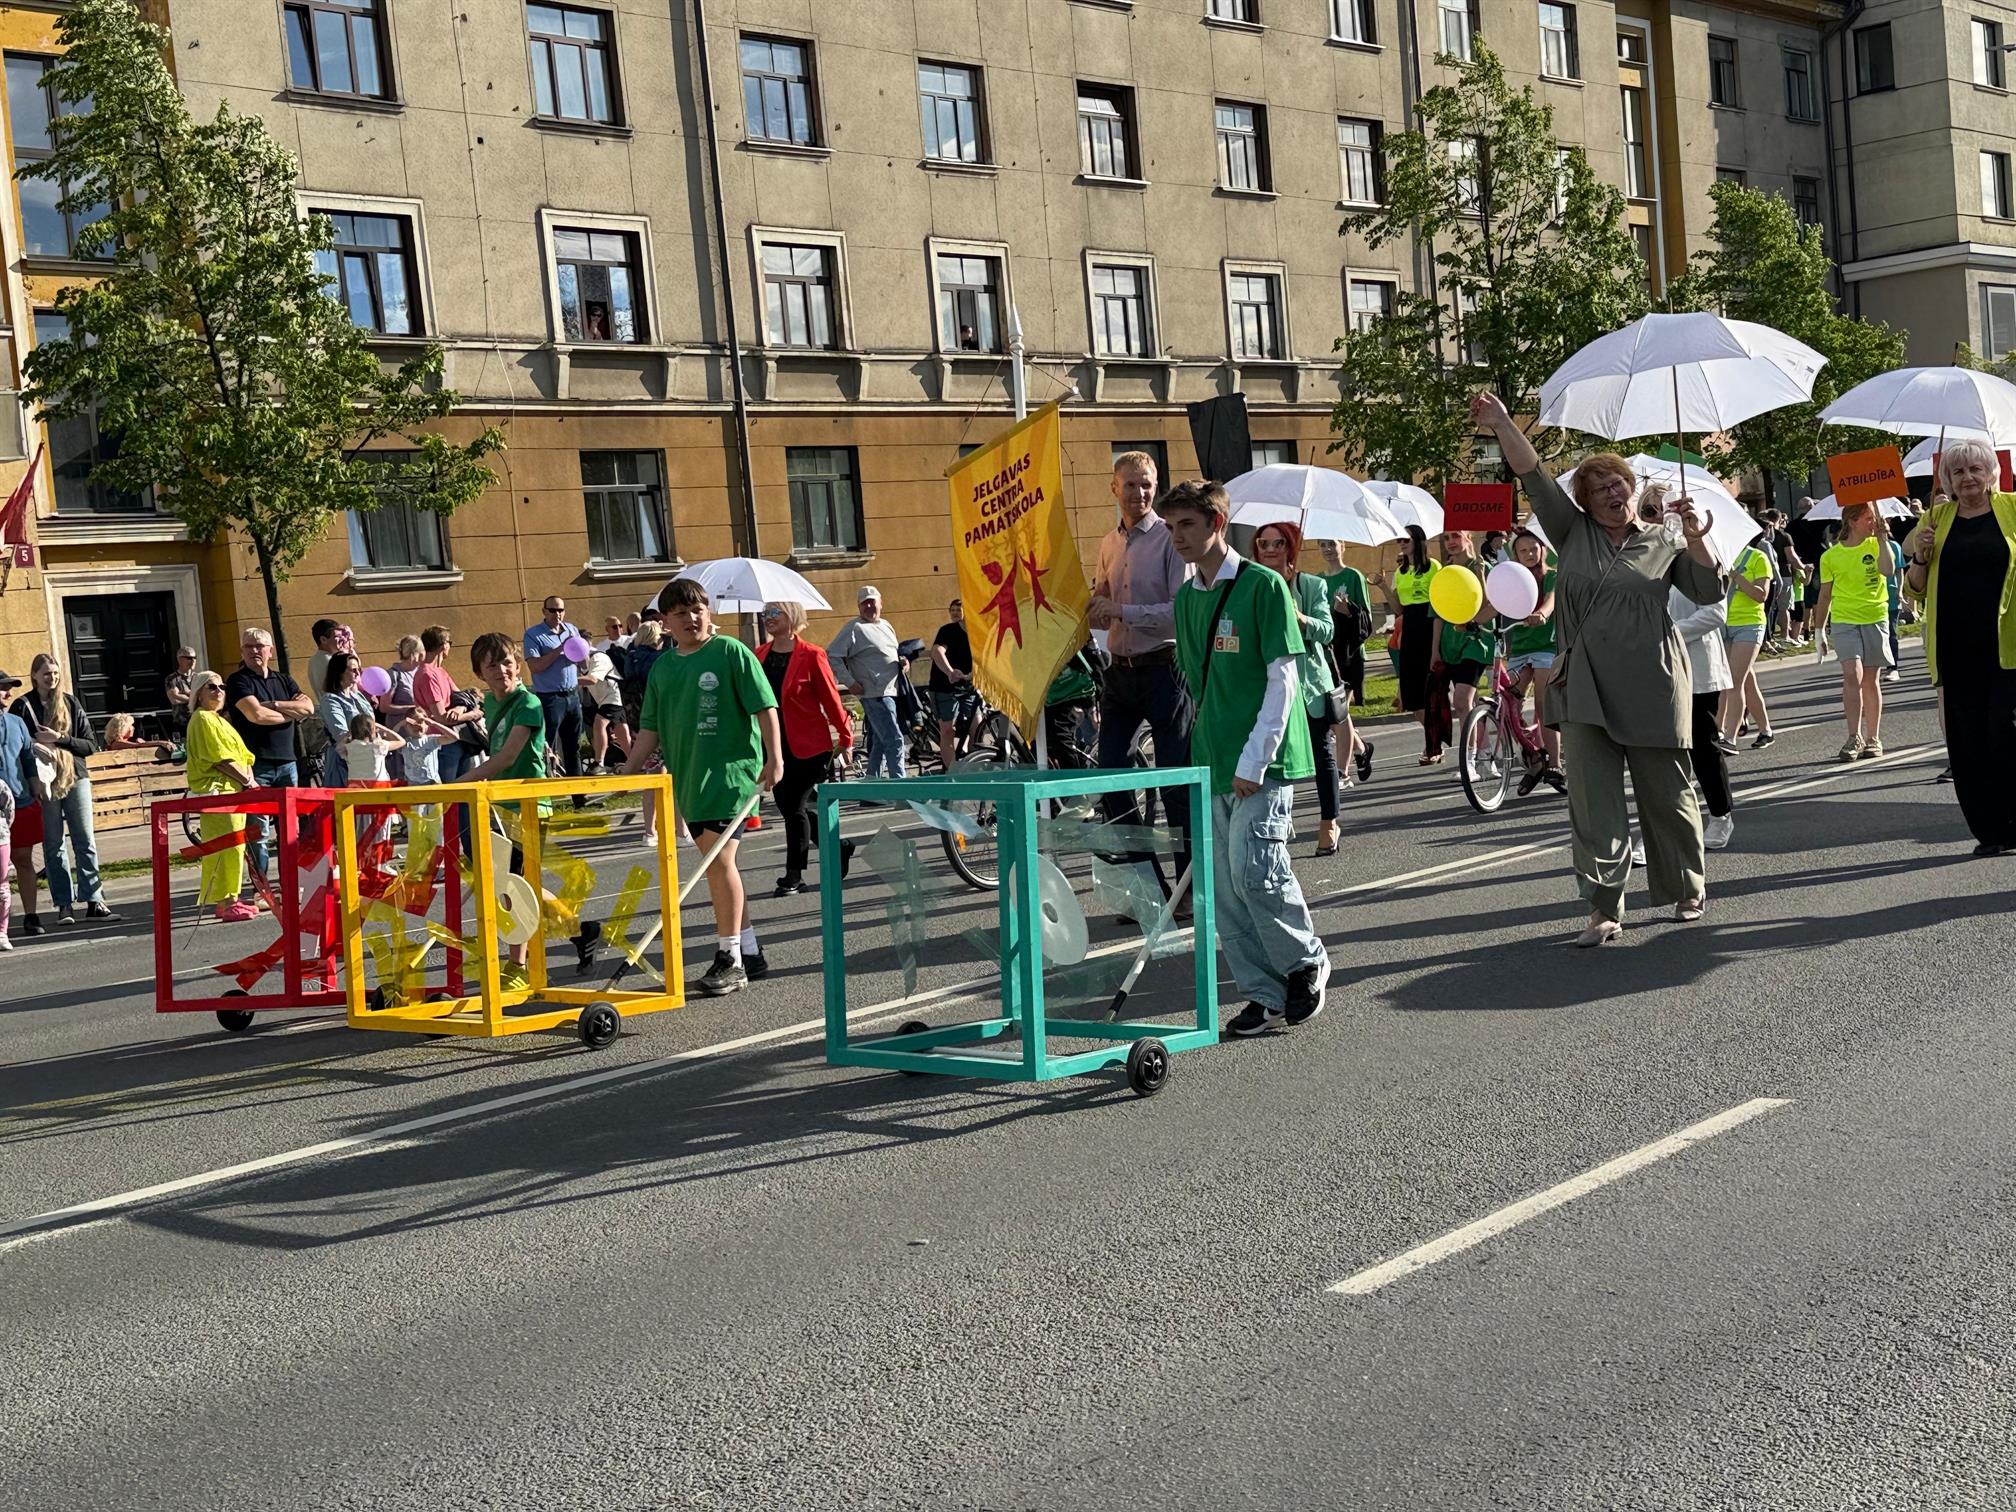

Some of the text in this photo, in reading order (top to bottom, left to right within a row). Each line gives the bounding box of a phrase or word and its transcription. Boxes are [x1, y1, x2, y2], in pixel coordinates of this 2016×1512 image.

[972, 453, 1031, 503] JELGAVAS
[1838, 469, 1896, 488] ATBILDĪBA
[981, 478, 1024, 517] CENTRA
[1453, 502, 1505, 513] DROSME
[964, 486, 1045, 548] PAMATSKOLA
[21, 549, 29, 562] 5
